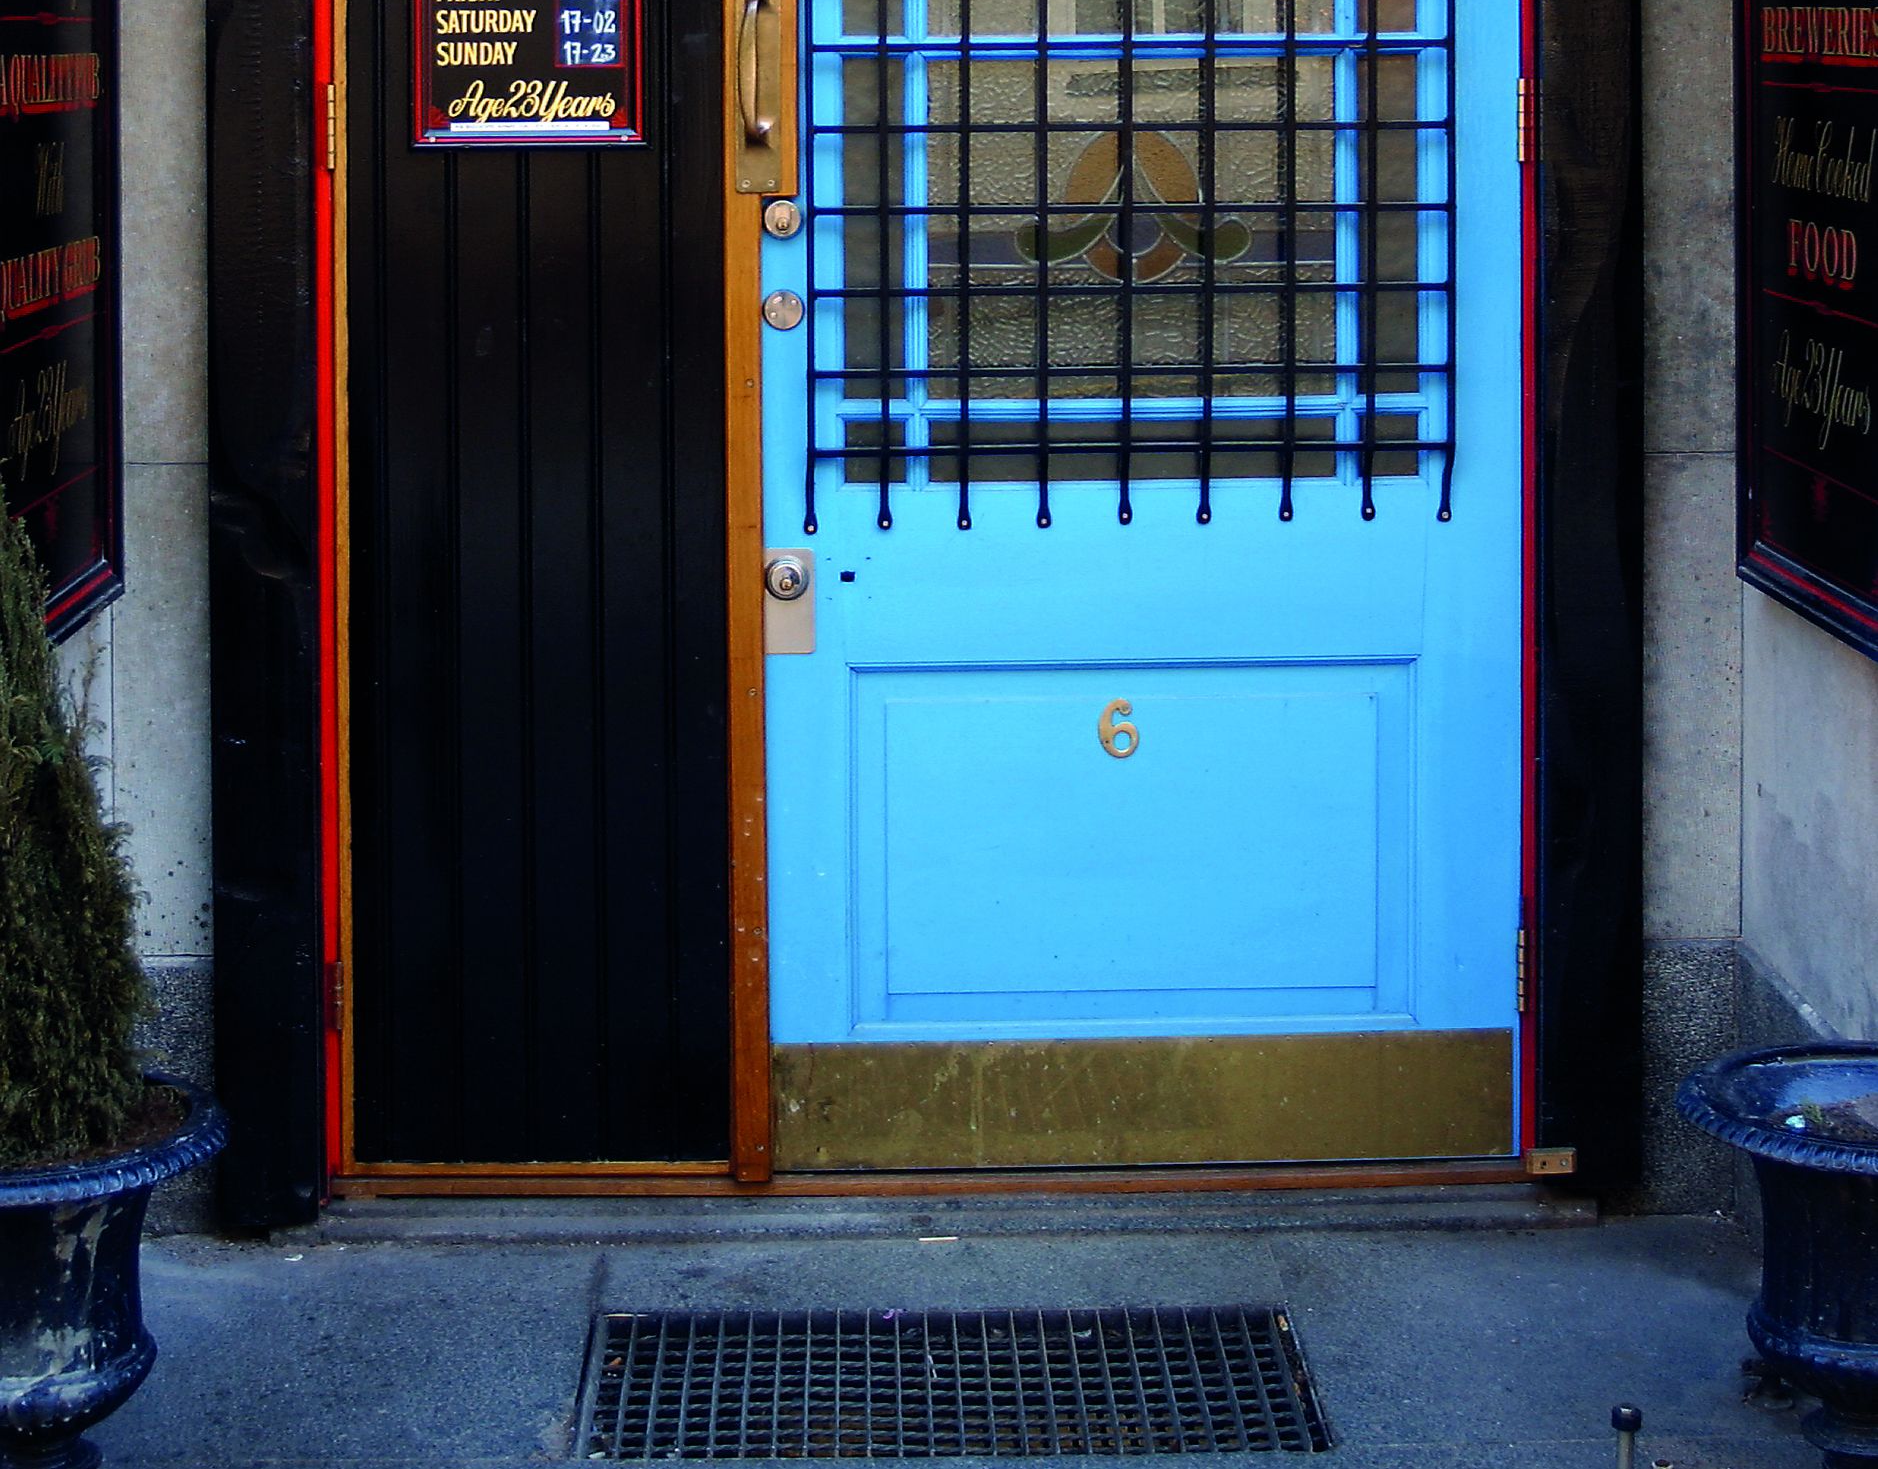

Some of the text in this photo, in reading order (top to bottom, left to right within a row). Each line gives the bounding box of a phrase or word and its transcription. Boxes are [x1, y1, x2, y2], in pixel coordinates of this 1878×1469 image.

[436, 9, 617, 35] SATURDAY 17-02
[436, 40, 617, 67] SUNDAY 17-23
[1772, 115, 1877, 203] Home Cooked
[1786, 217, 1857, 281] FOOD
[1771, 329, 1871, 450] Age 23 Years
[1098, 697, 1139, 759] 6
